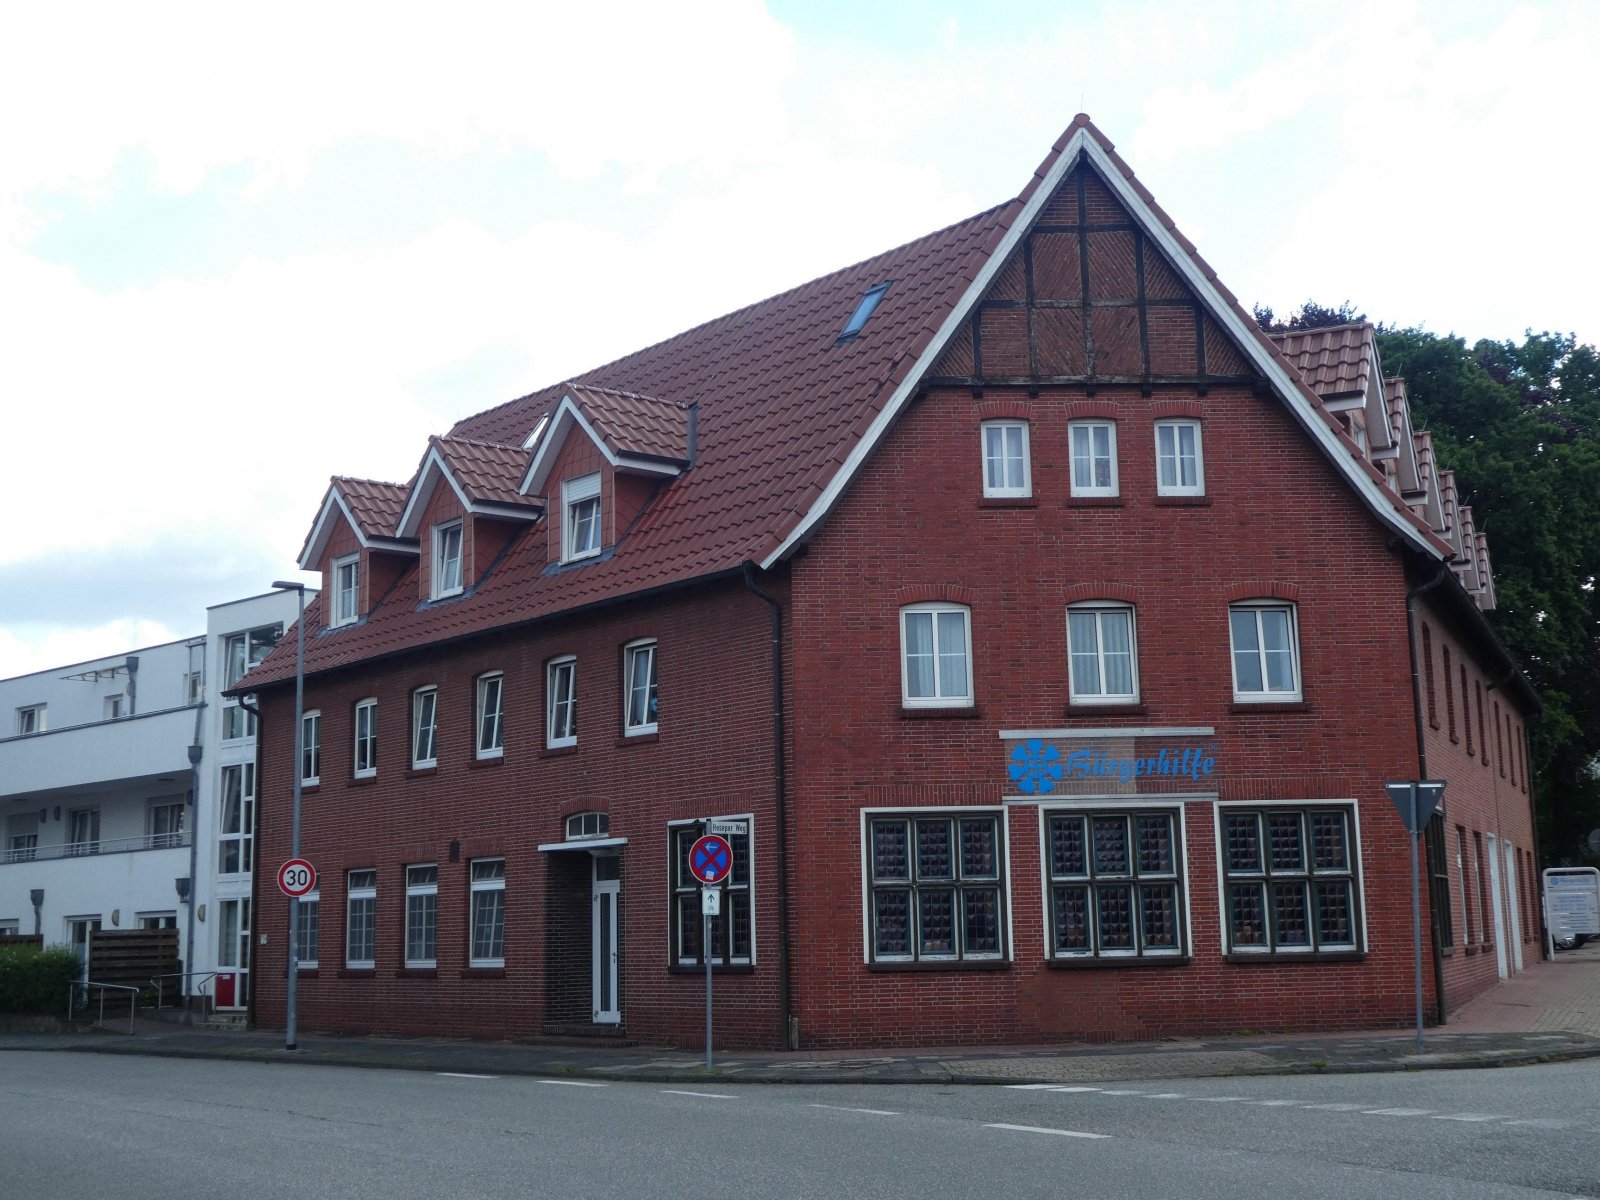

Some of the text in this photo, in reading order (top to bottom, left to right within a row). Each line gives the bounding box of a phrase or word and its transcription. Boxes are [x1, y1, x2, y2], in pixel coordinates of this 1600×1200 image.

[1066, 748, 1215, 783] Bürgerhilfe
[735, 823, 747, 834] Weg
[286, 870, 307, 886] 30
